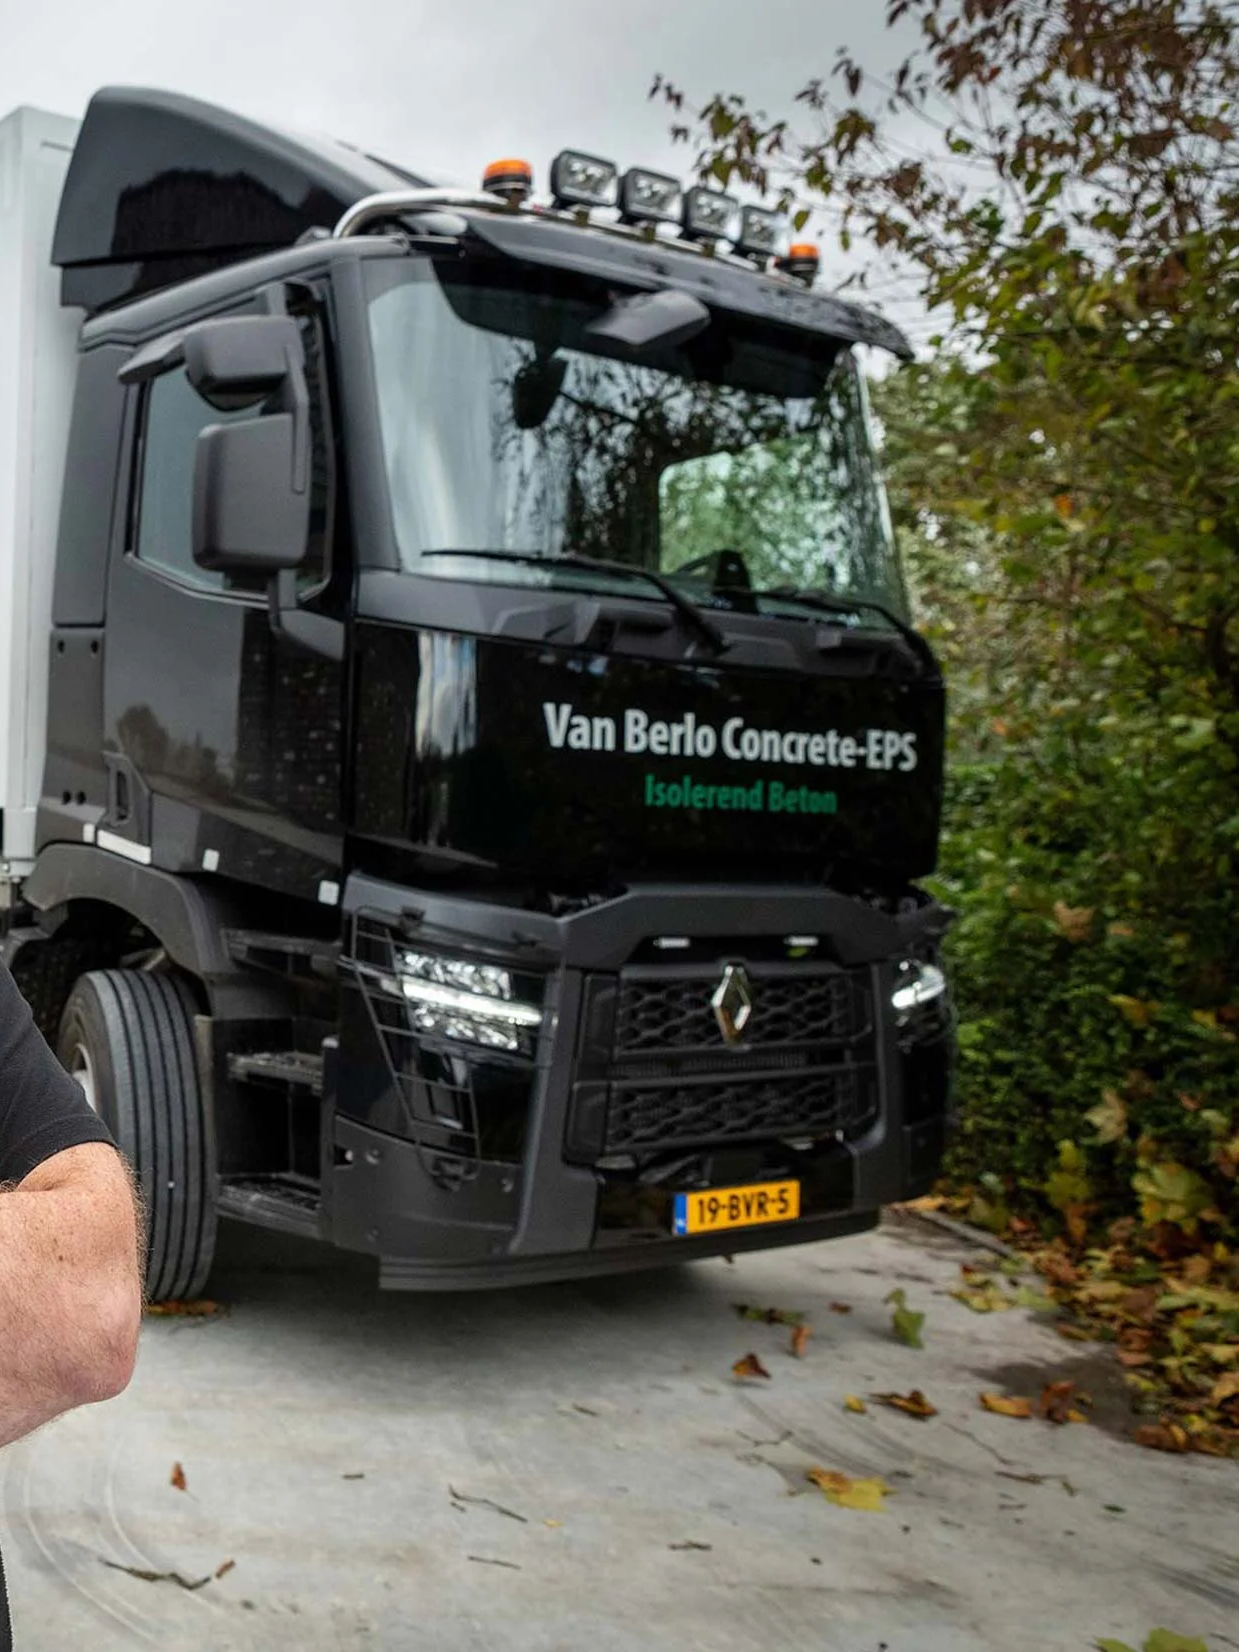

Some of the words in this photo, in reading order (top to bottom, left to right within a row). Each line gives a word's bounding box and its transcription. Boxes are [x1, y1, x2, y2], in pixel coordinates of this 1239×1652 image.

[543, 702, 616, 751] Van
[624, 708, 716, 758] Berlo
[722, 716, 918, 772] Concrete-EPS
[644, 773, 763, 810] Isolerend
[768, 780, 838, 815] Beton
[698, 1188, 789, 1224] 19-BVR-5
